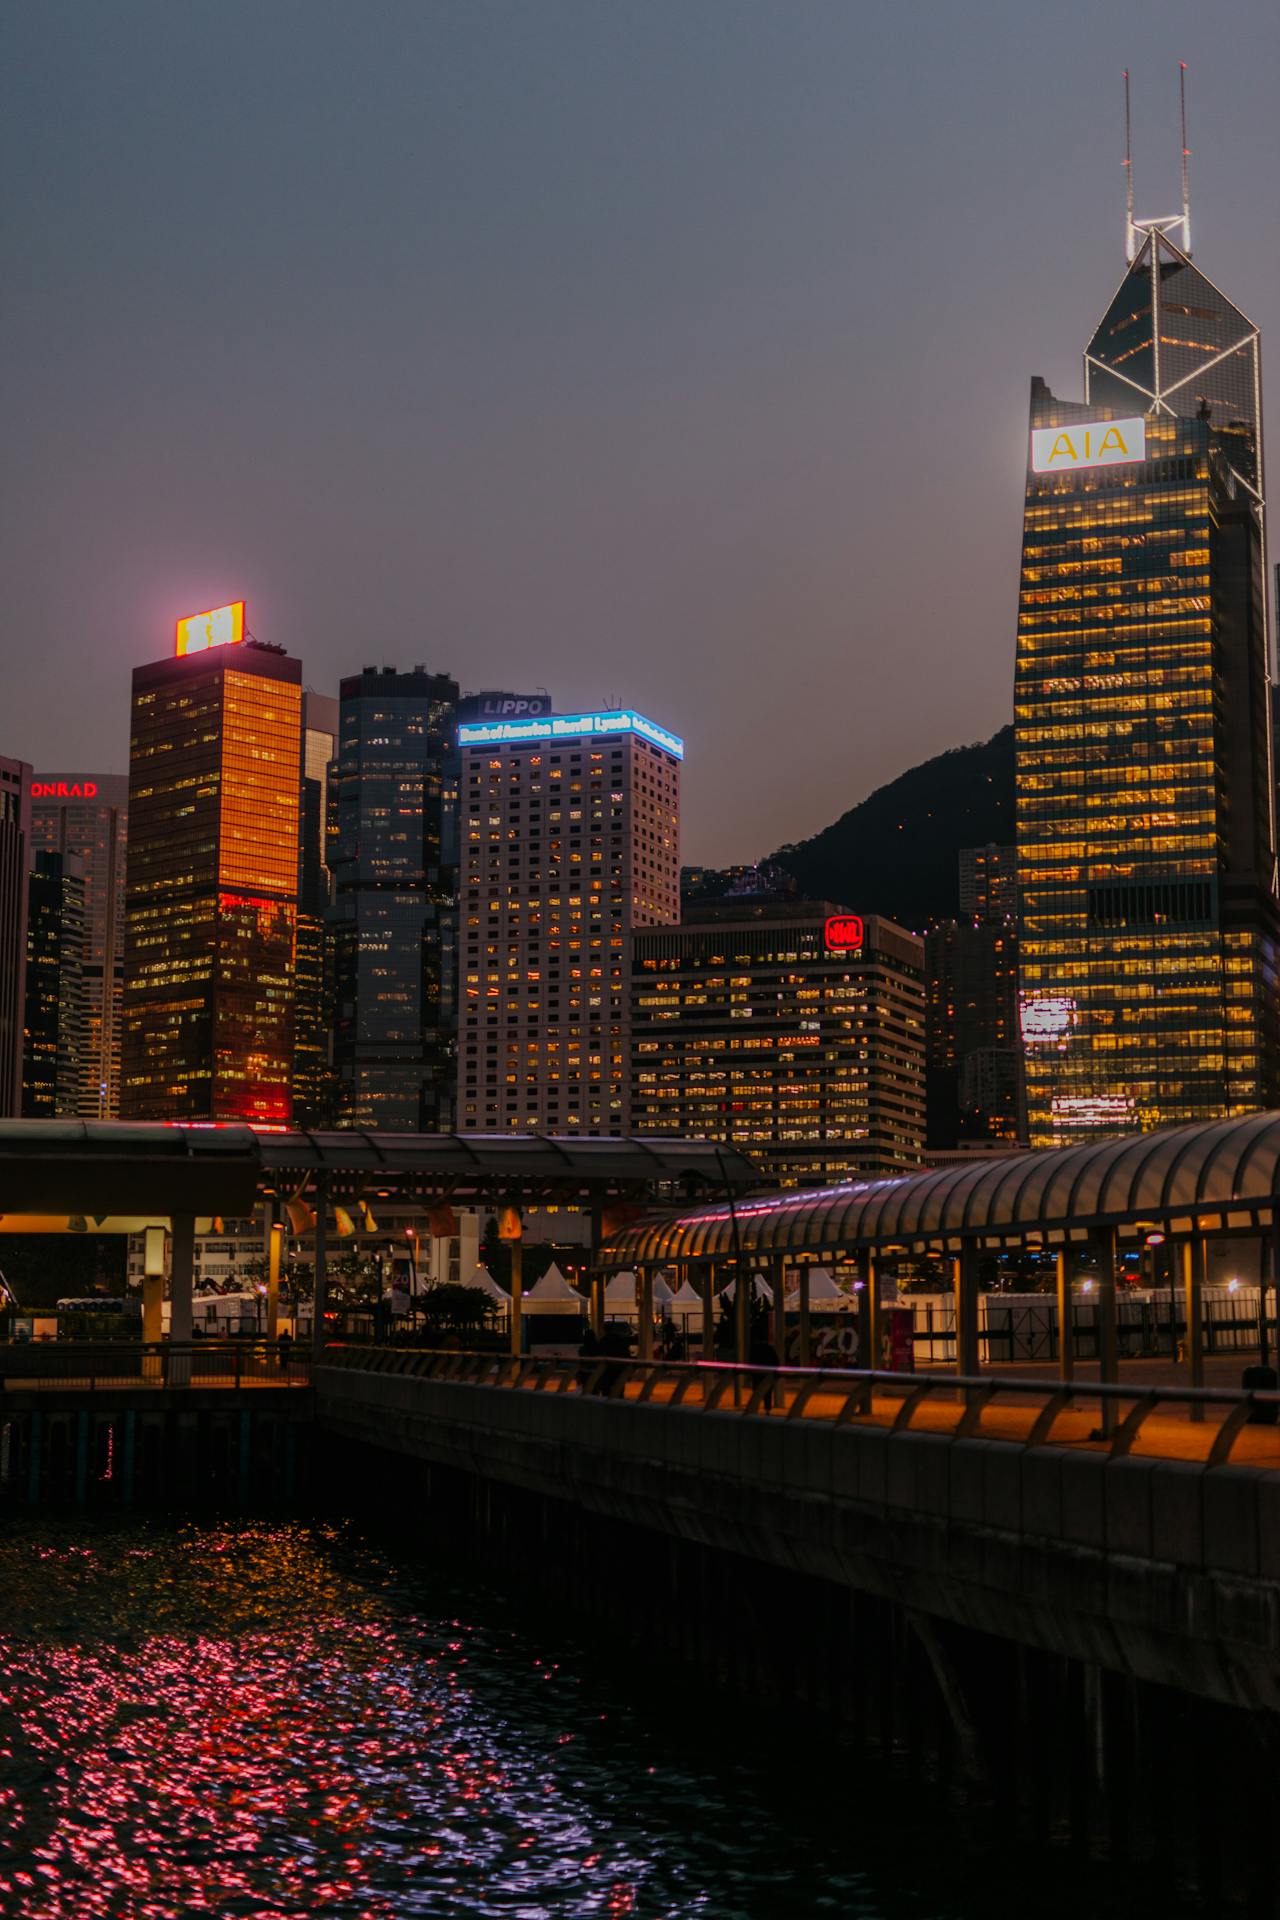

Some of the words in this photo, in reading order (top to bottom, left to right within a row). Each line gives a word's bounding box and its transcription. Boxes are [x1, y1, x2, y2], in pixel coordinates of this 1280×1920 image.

[1047, 427, 1128, 464] AIA
[484, 700, 543, 714] LIPPO
[31, 782, 97, 798] ONRAD
